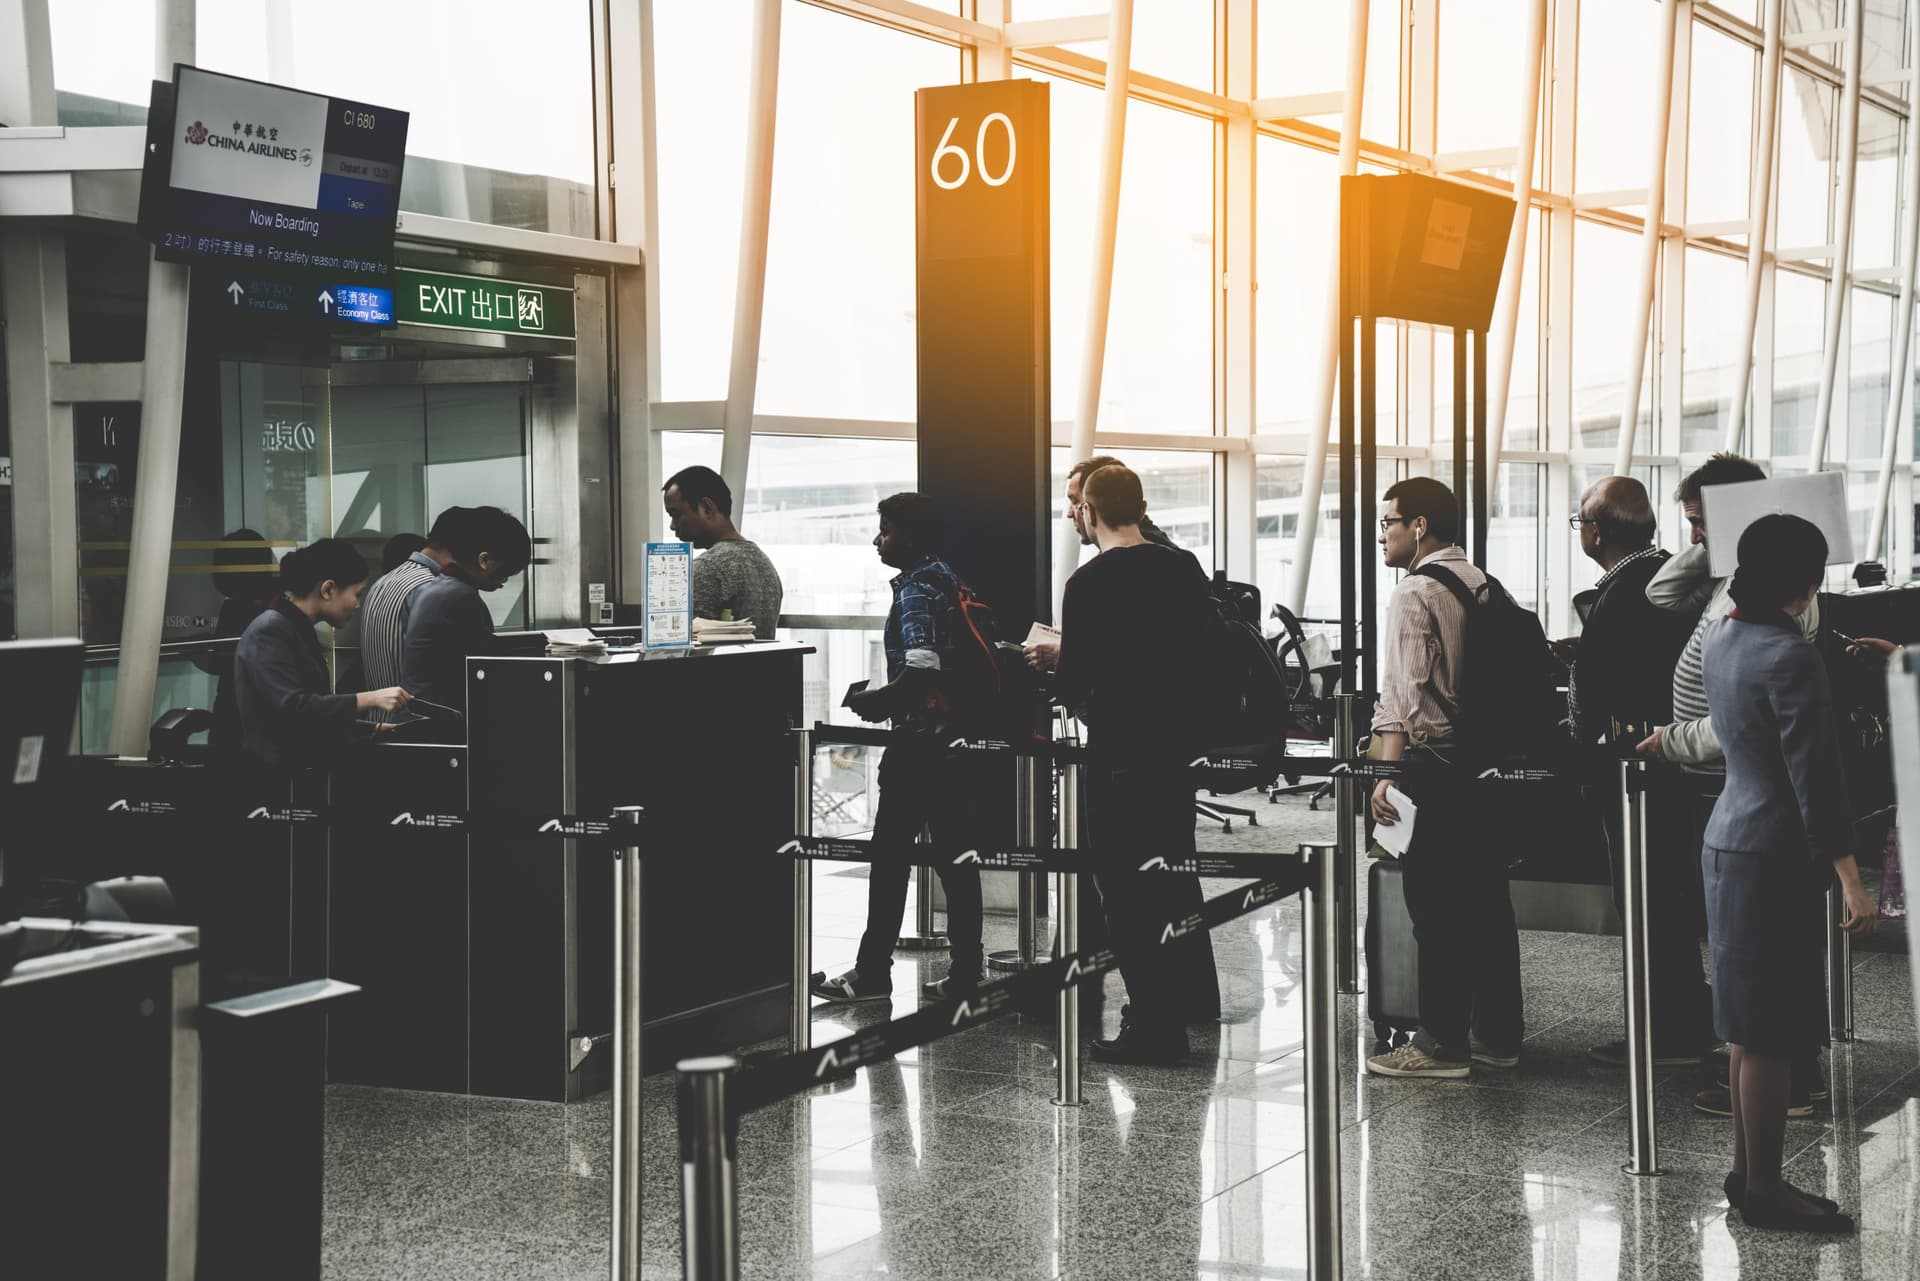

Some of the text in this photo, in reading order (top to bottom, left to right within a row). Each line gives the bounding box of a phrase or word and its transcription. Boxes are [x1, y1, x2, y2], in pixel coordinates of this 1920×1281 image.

[232, 119, 280, 142] 中華航空
[344, 110, 376, 131] CI 680
[207, 134, 298, 161] CHINA AIRLINES
[929, 111, 1017, 191] 60
[249, 209, 319, 236] Now Boarding
[268, 246, 282, 260] For
[284, 251, 309, 266] safety
[343, 258, 360, 272] only
[361, 261, 376, 273] one
[337, 306, 390, 321] Economy Class
[418, 284, 515, 322] EXIT 出口
